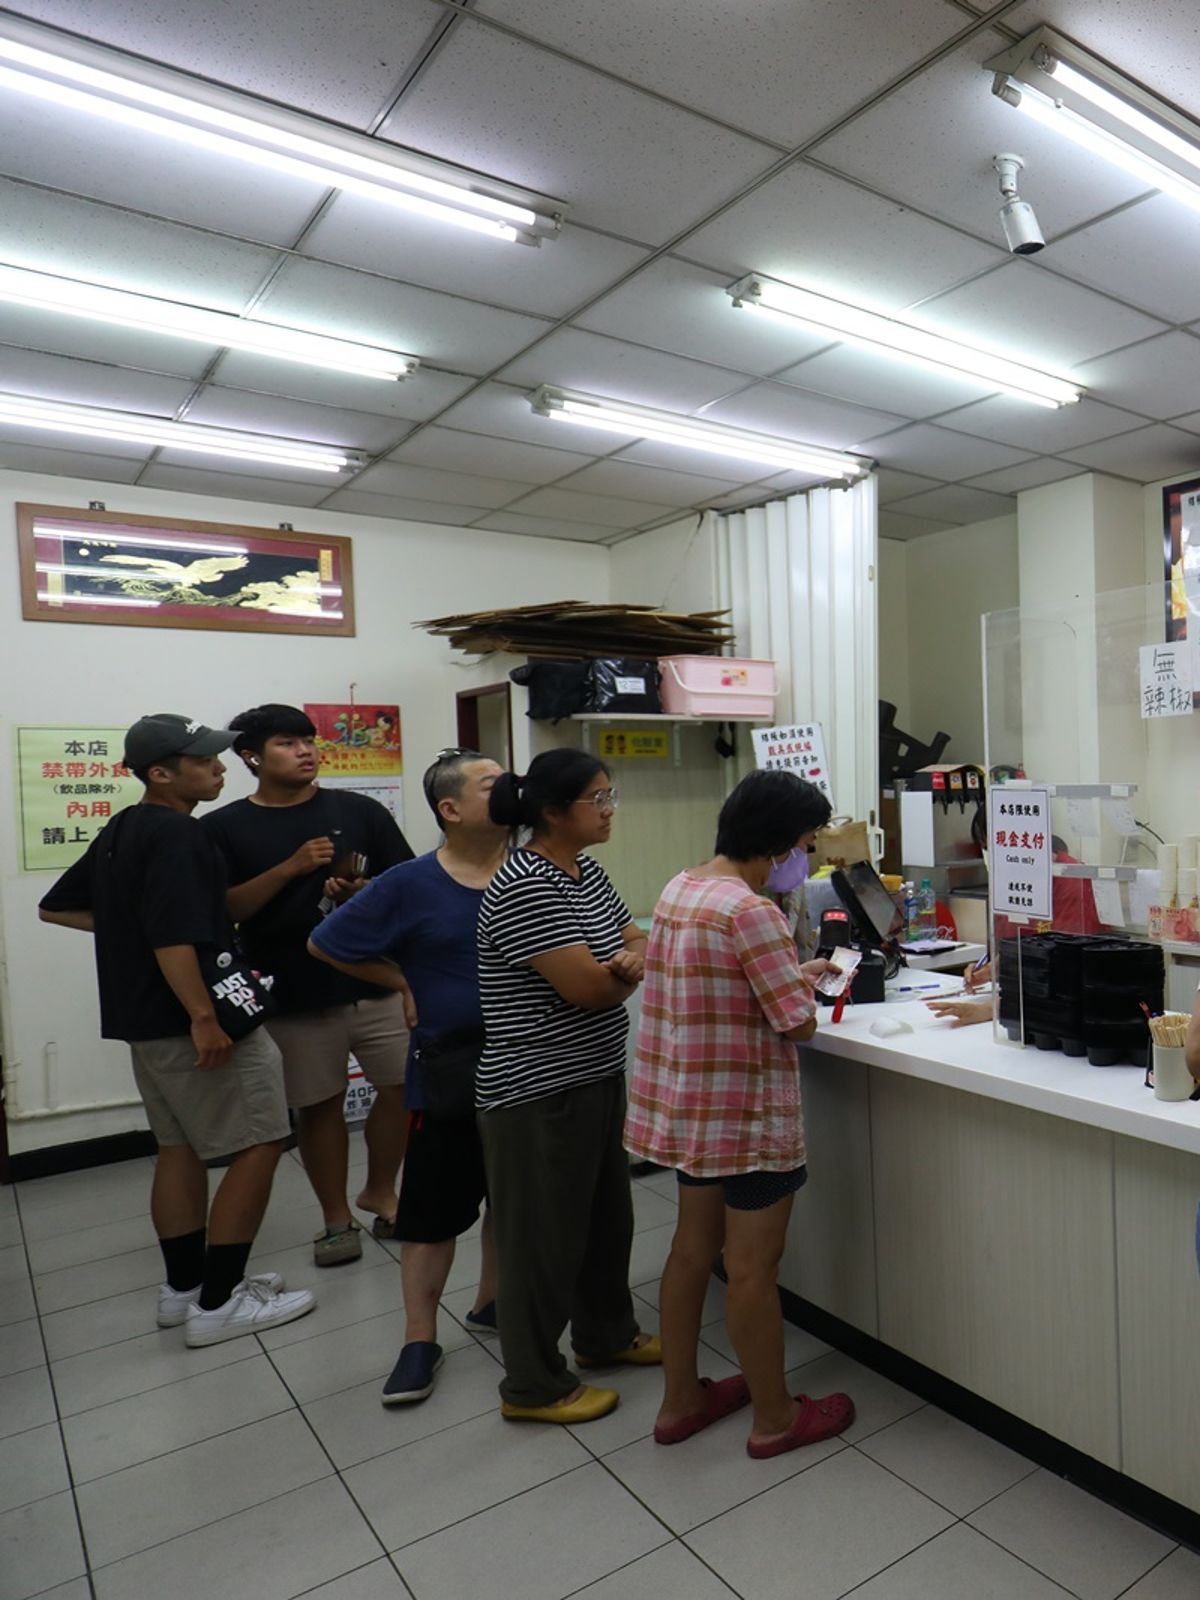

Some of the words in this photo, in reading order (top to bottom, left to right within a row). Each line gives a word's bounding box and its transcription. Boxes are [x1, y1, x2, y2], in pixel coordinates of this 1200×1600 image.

[65, 740, 108, 756] 本店
[42, 761, 131, 779] 禁帶外食
[67, 801, 112, 818] 內用
[1000, 804, 1040, 816] 本店限使用
[42, 826, 104, 845] 請上
[996, 831, 1044, 849] 現金支付
[1006, 854, 1019, 863] Cash
[1022, 856, 1035, 865] only
[212, 972, 248, 999] JUST
[227, 986, 254, 1007] DO
